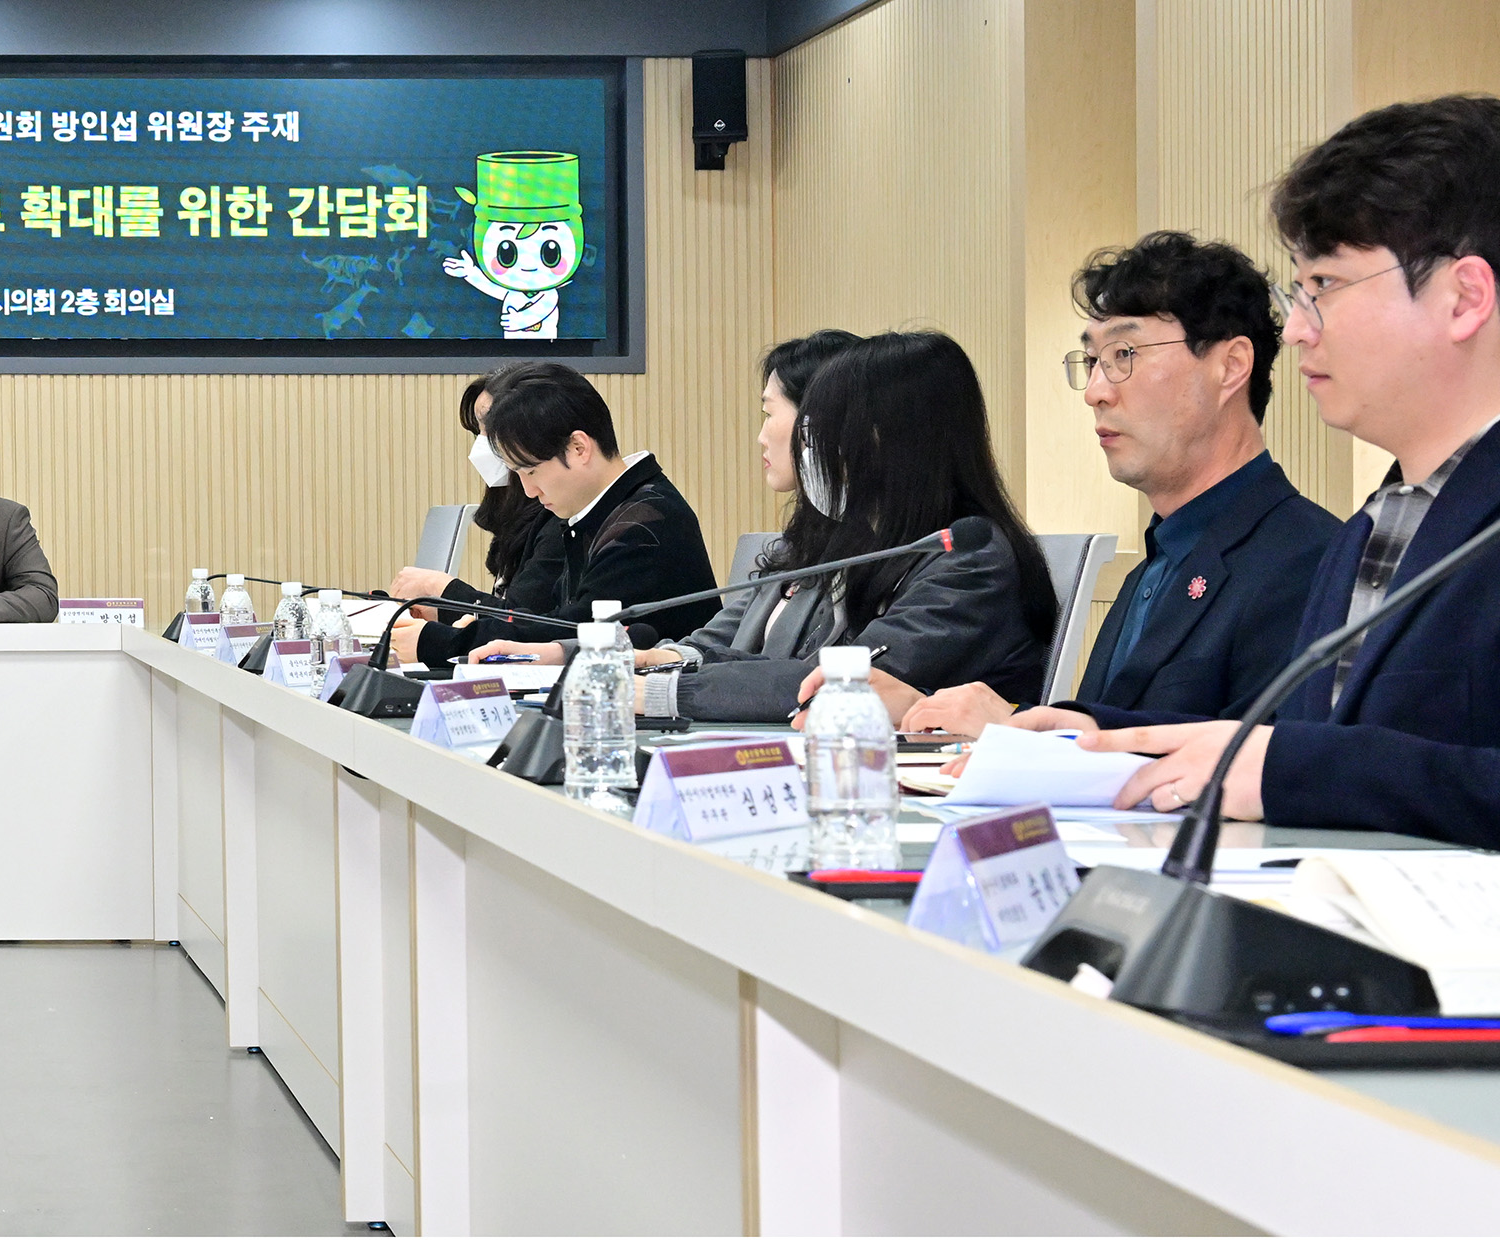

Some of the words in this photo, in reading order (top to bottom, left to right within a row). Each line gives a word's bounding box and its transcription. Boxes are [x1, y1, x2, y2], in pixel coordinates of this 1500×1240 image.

[52, 110, 137, 142] 방인섭
[147, 110, 235, 142] 위원장
[241, 110, 299, 142] 주재
[20, 185, 164, 238] 확대를
[177, 185, 273, 238] 위한
[287, 185, 429, 238] 간담회
[60, 288, 100, 316] 2층
[104, 288, 175, 316] 회의실
[100, 613, 136, 624] 방인섭
